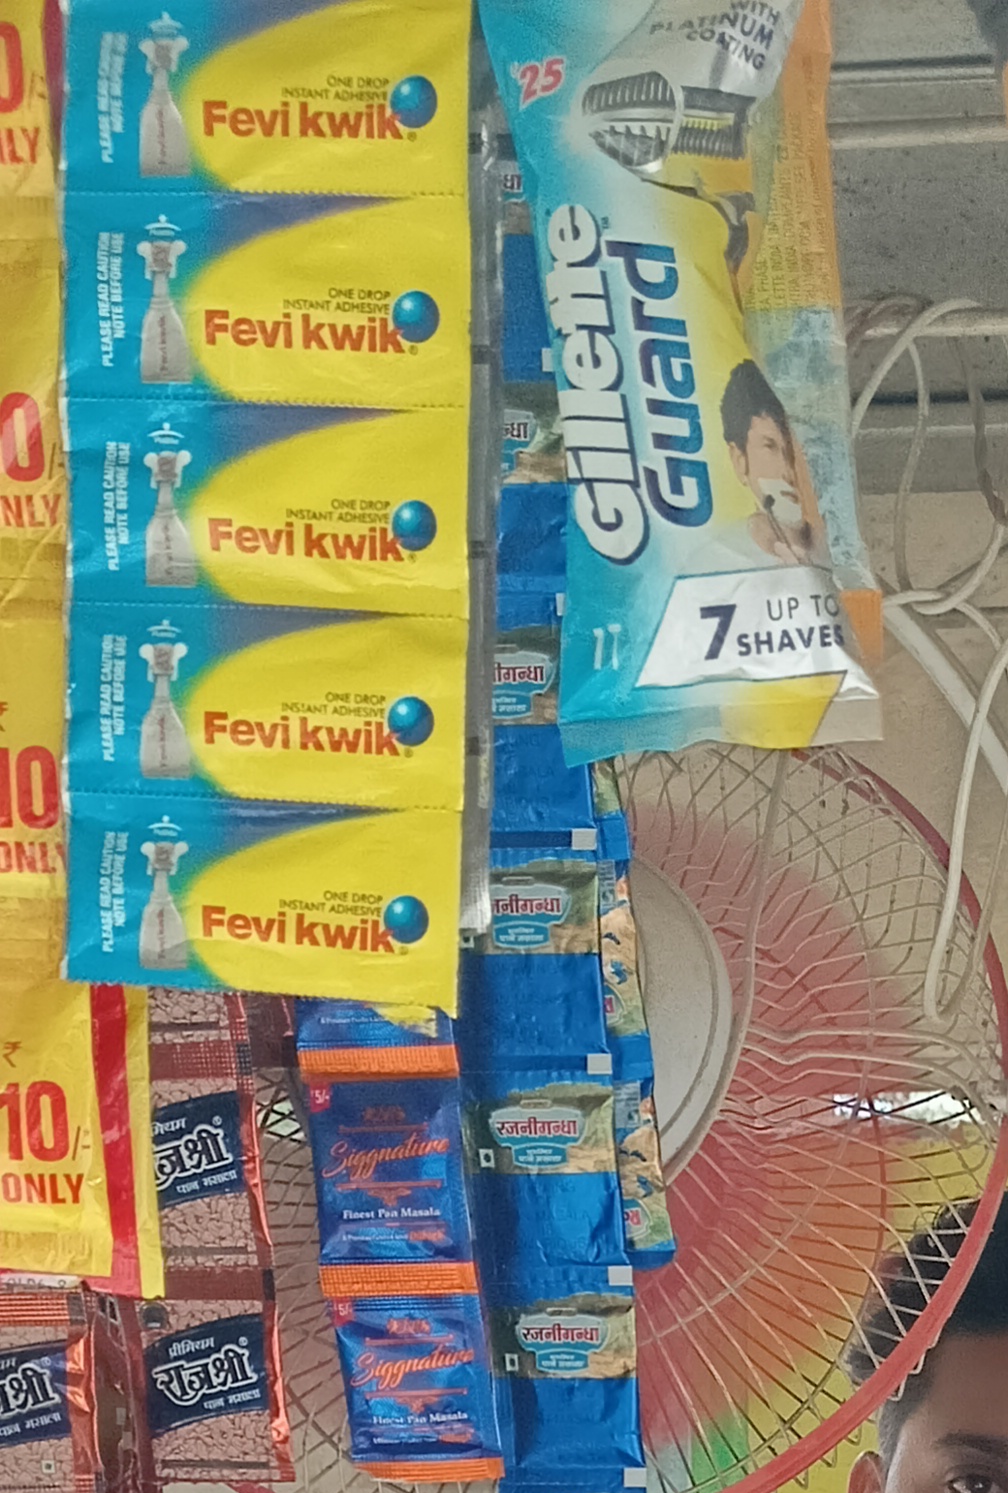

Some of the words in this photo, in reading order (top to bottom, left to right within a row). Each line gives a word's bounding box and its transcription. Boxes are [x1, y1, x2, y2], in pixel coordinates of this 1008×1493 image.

[731, 0, 780, 24] WITH
[651, 13, 774, 50] PLATINUM
[686, 29, 765, 71] COATING
[327, 75, 355, 87] ONE
[358, 77, 390, 89] DROP
[282, 88, 331, 99] INSTANT
[334, 89, 388, 101] ADHESIVE
[328, 288, 355, 299] ONE
[358, 289, 391, 301] DROP
[283, 299, 333, 311] INSTANT
[336, 302, 390, 315] ADHESIVE
[546, 204, 650, 565] Gillette
[605, 240, 713, 527] Guard
[700, 604, 737, 662] 7
[766, 598, 798, 621] UP
[810, 595, 841, 618] TO
[736, 624, 845, 657] SHAVES
[323, 890, 349, 903] ONE
[352, 892, 383, 905] DROP
[279, 899, 325, 912] INSTANT
[329, 903, 382, 917] ADHESIVE
[495, 1117, 578, 1137] रजनीगन्धा
[2, 1173, 84, 1204] ONLY
[343, 1209, 375, 1220] Finest
[378, 1208, 398, 1218] Pan
[400, 1207, 441, 1218] Masala
[522, 1323, 599, 1343] रजनीगन्धा
